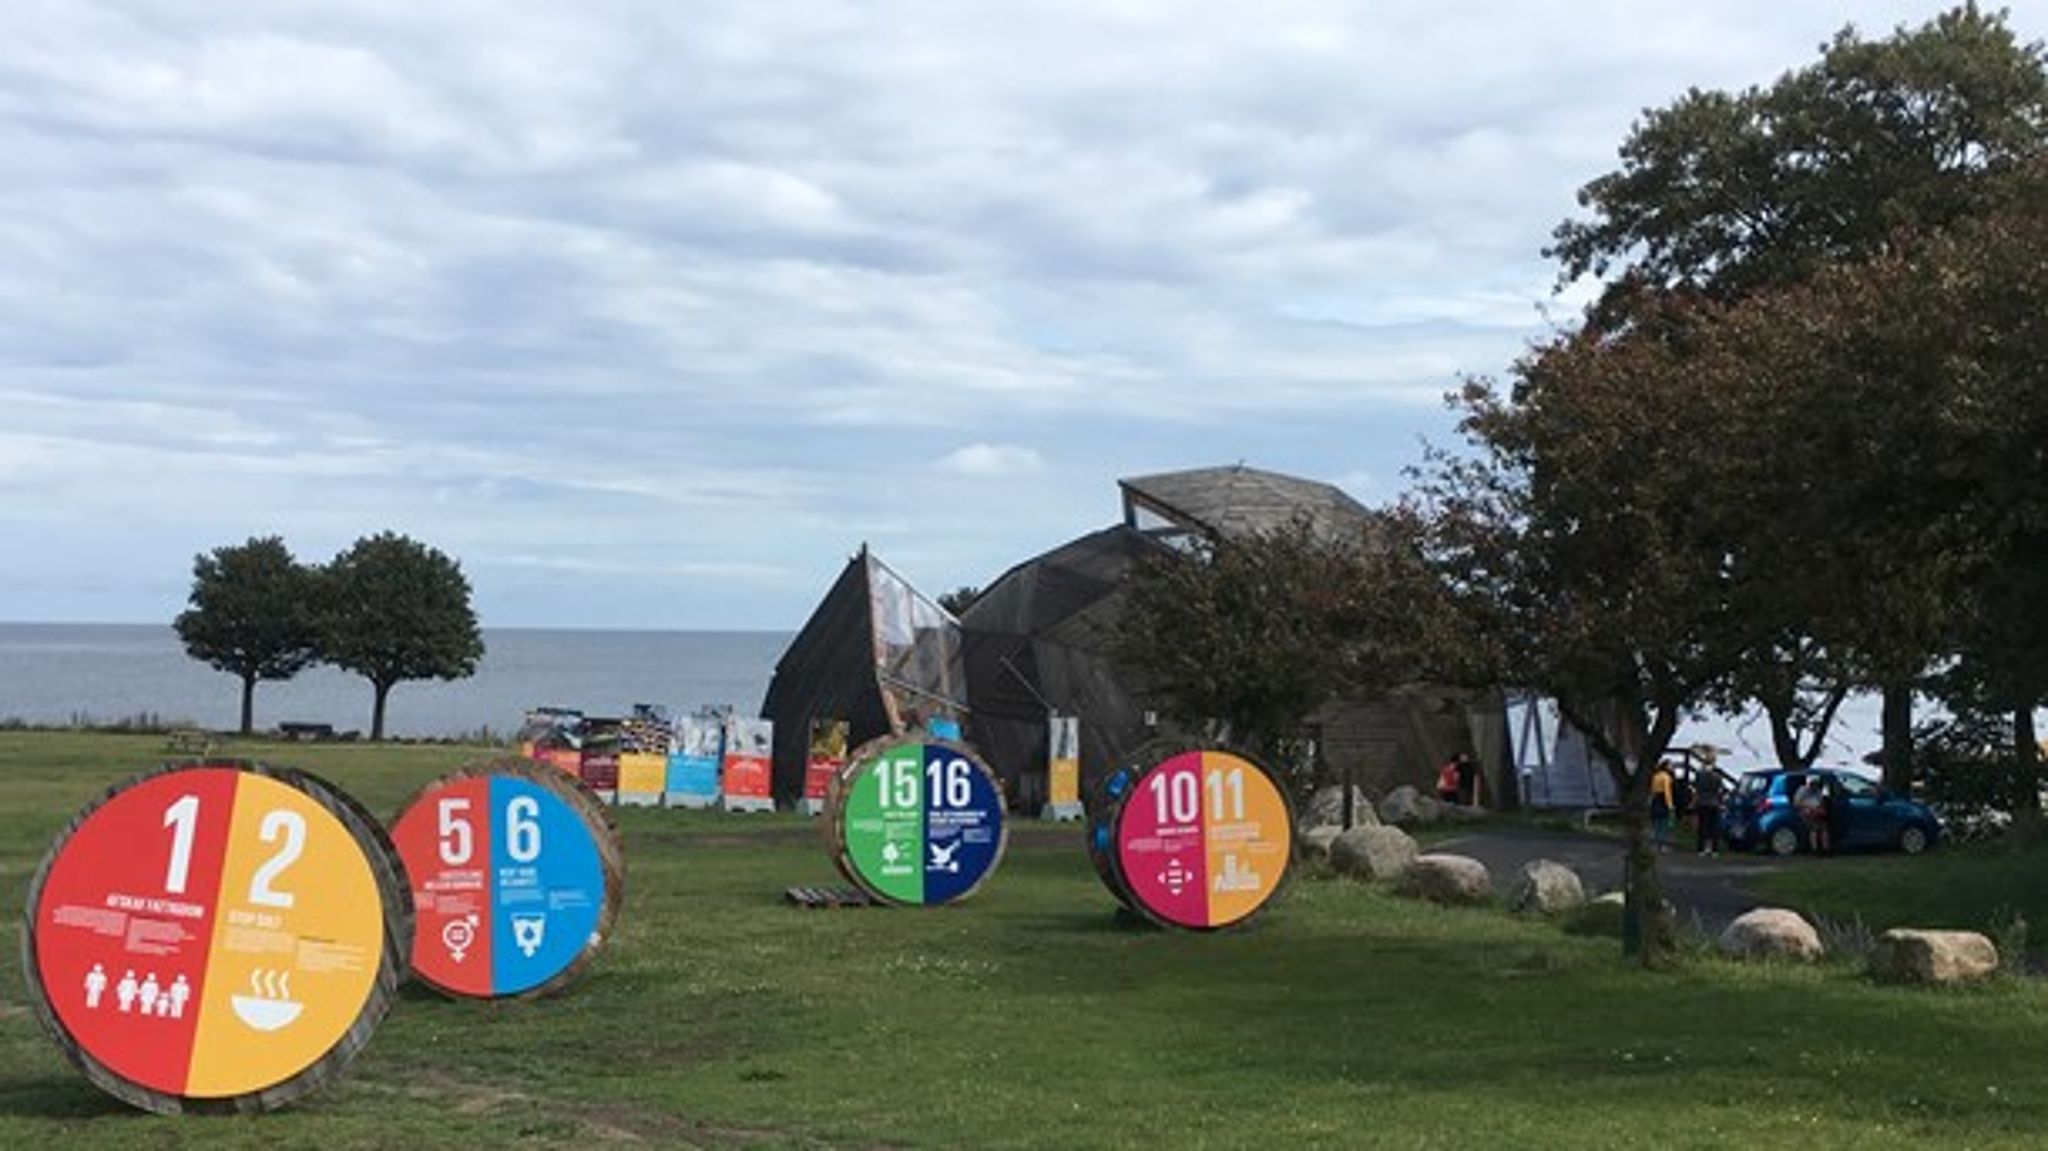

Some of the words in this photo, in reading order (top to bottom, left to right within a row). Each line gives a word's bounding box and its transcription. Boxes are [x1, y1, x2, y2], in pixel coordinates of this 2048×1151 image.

[873, 758, 918, 808] 15
[926, 758, 972, 808] 16
[1151, 771, 1199, 824] 10
[1206, 767, 1244, 821] 11
[163, 794, 199, 894] 1
[249, 809, 307, 907] 2
[438, 798, 474, 866] 5
[506, 795, 541, 863] 6
